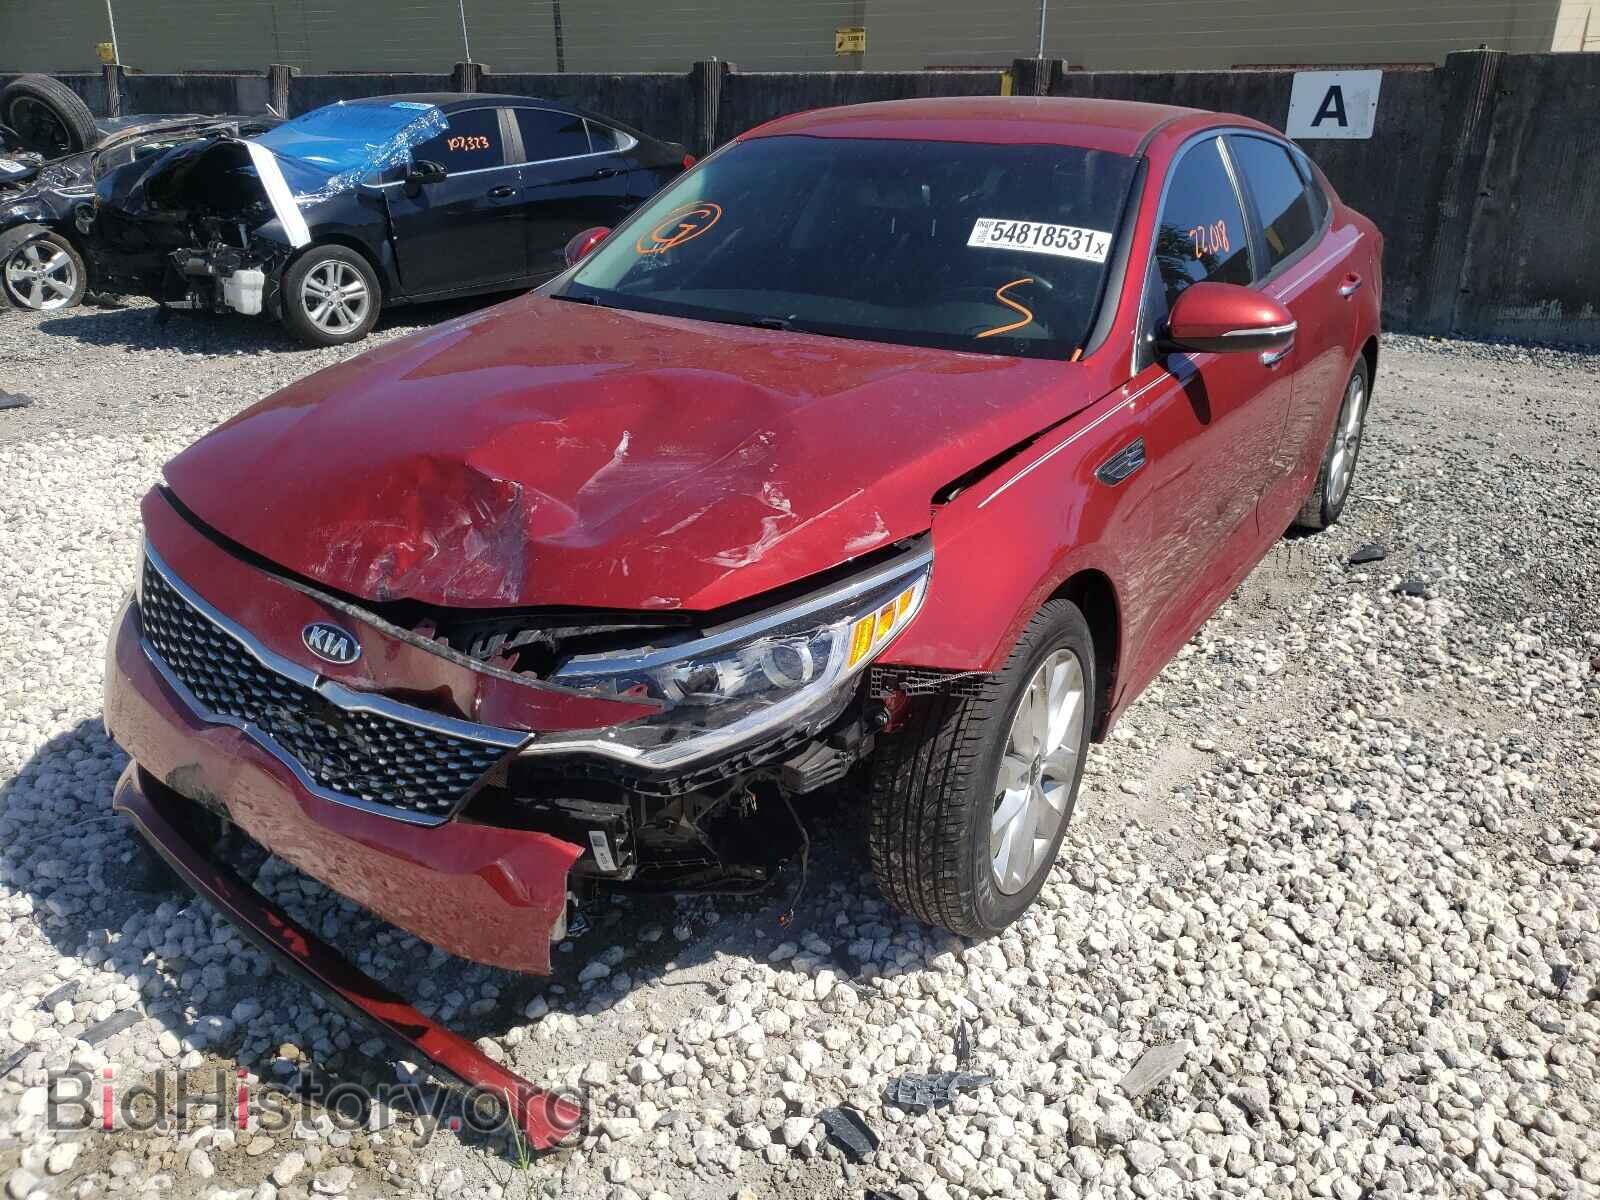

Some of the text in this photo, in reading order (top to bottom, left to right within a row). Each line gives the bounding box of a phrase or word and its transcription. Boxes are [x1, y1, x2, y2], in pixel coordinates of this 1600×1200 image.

[1310, 85, 1348, 127] A
[976, 278, 1034, 338] S
[308, 625, 348, 660] KIA
